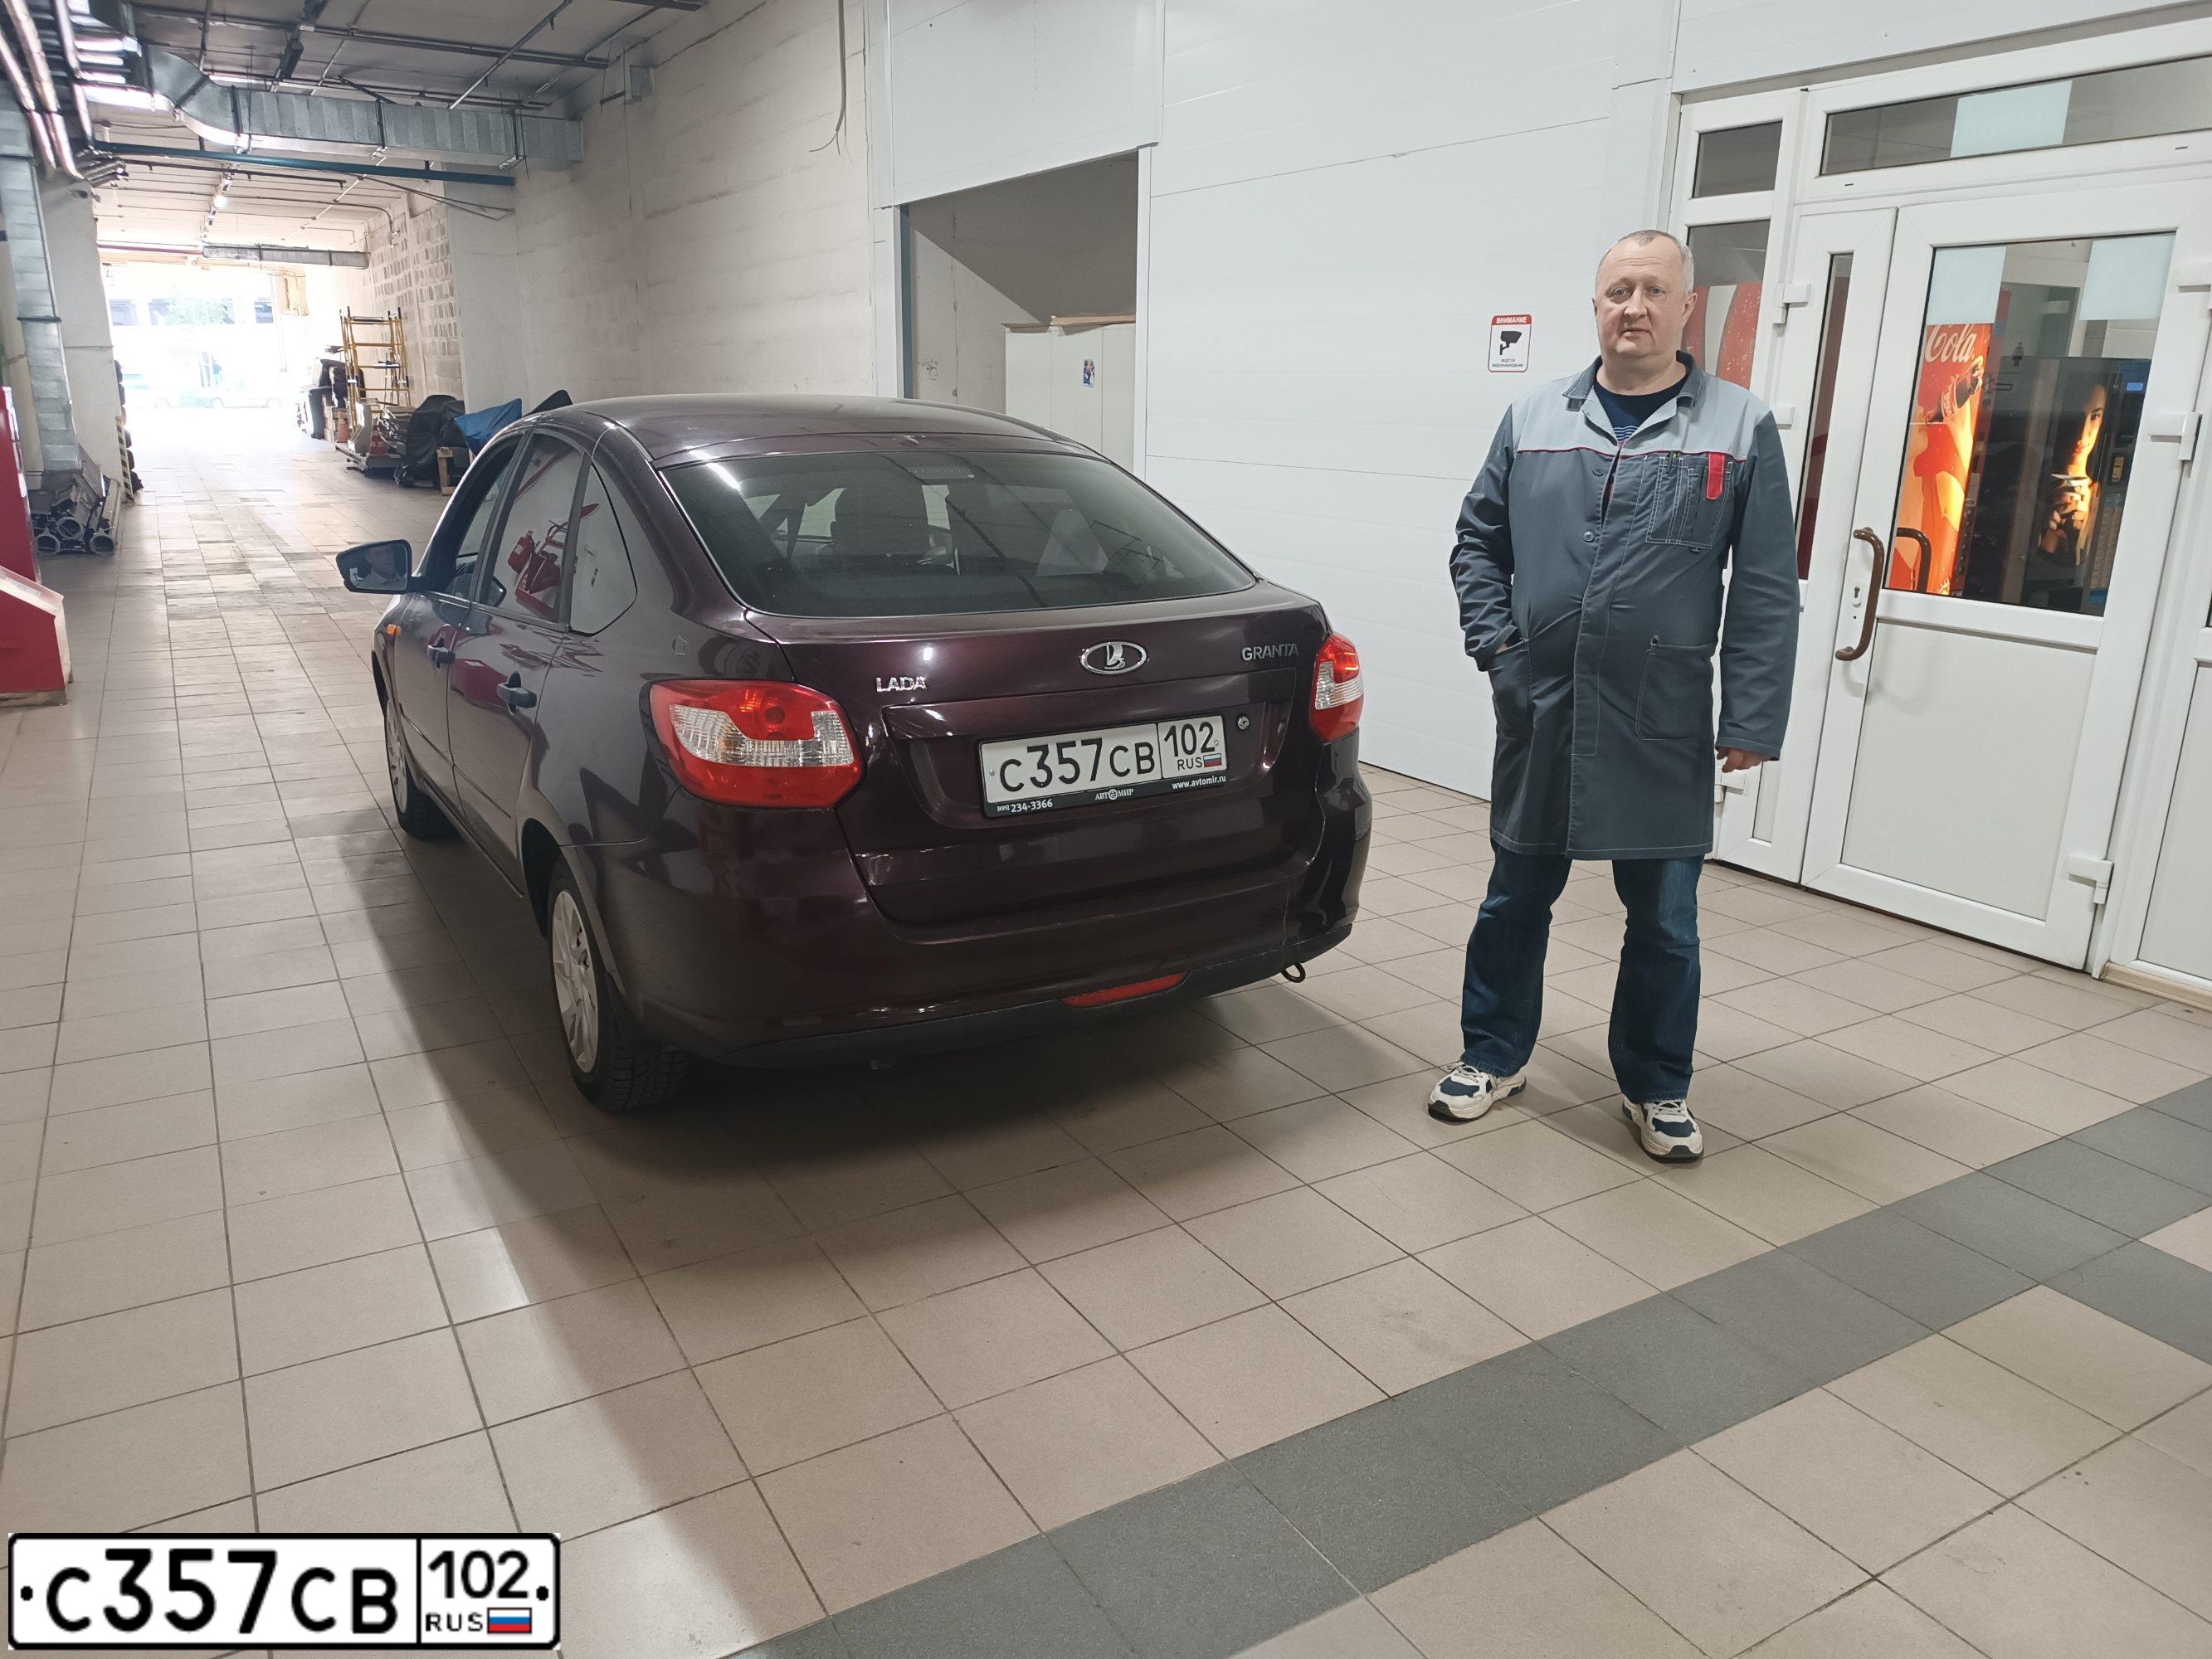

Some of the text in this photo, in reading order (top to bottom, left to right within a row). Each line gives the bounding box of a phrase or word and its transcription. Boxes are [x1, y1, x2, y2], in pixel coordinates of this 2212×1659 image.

[1925, 324, 1977, 363] Cola
[1241, 643, 1299, 661] GRANTA
[876, 676, 928, 693] LADA
[1163, 721, 1216, 757] 102
[1177, 757, 1203, 771] RUS
[1172, 775, 1226, 790] www.avtomir.ru
[1011, 798, 1053, 813] 234-3366
